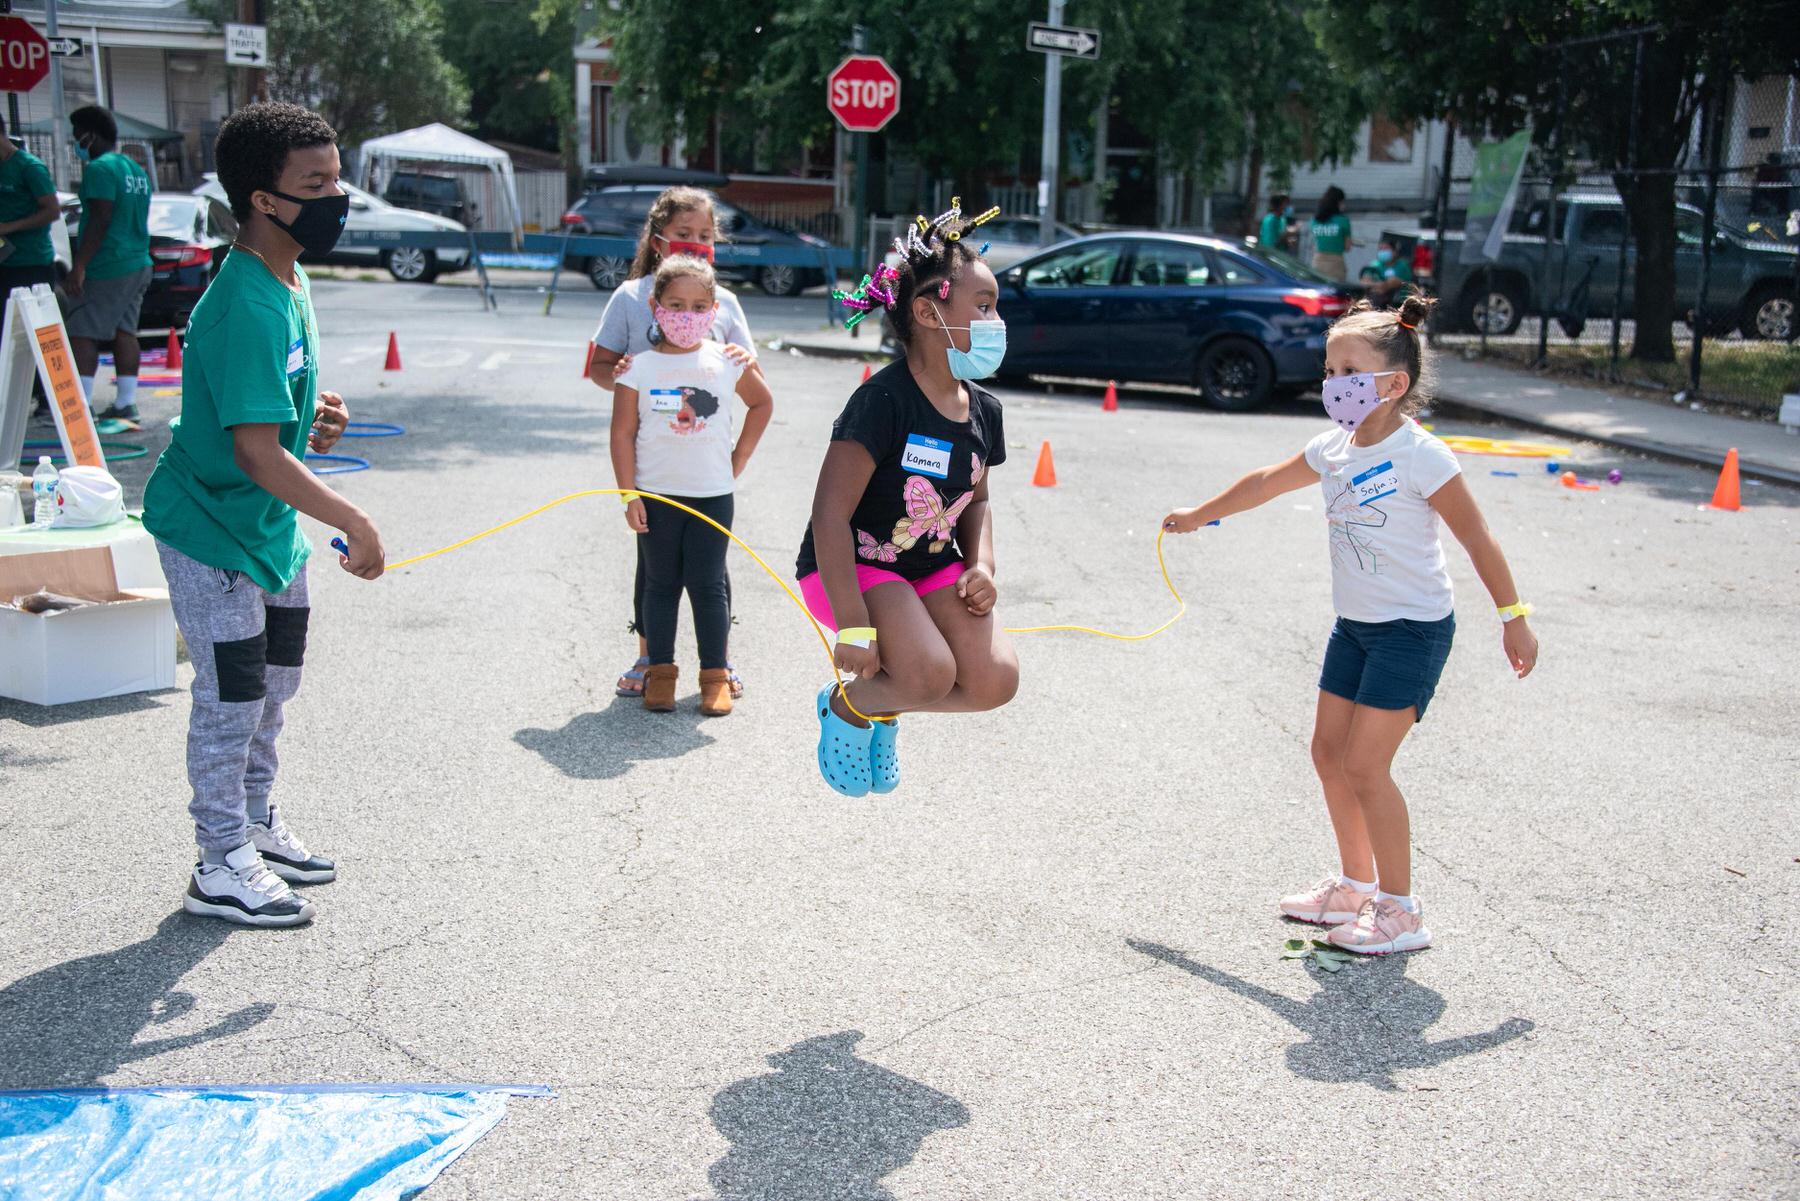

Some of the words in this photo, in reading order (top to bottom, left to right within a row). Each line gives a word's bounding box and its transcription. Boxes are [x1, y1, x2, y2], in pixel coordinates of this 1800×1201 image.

[238, 28, 255, 39] ALL
[231, 39, 263, 49] TRAFFIC
[833, 79, 895, 109] STOP
[907, 452, 940, 469] Kamara
